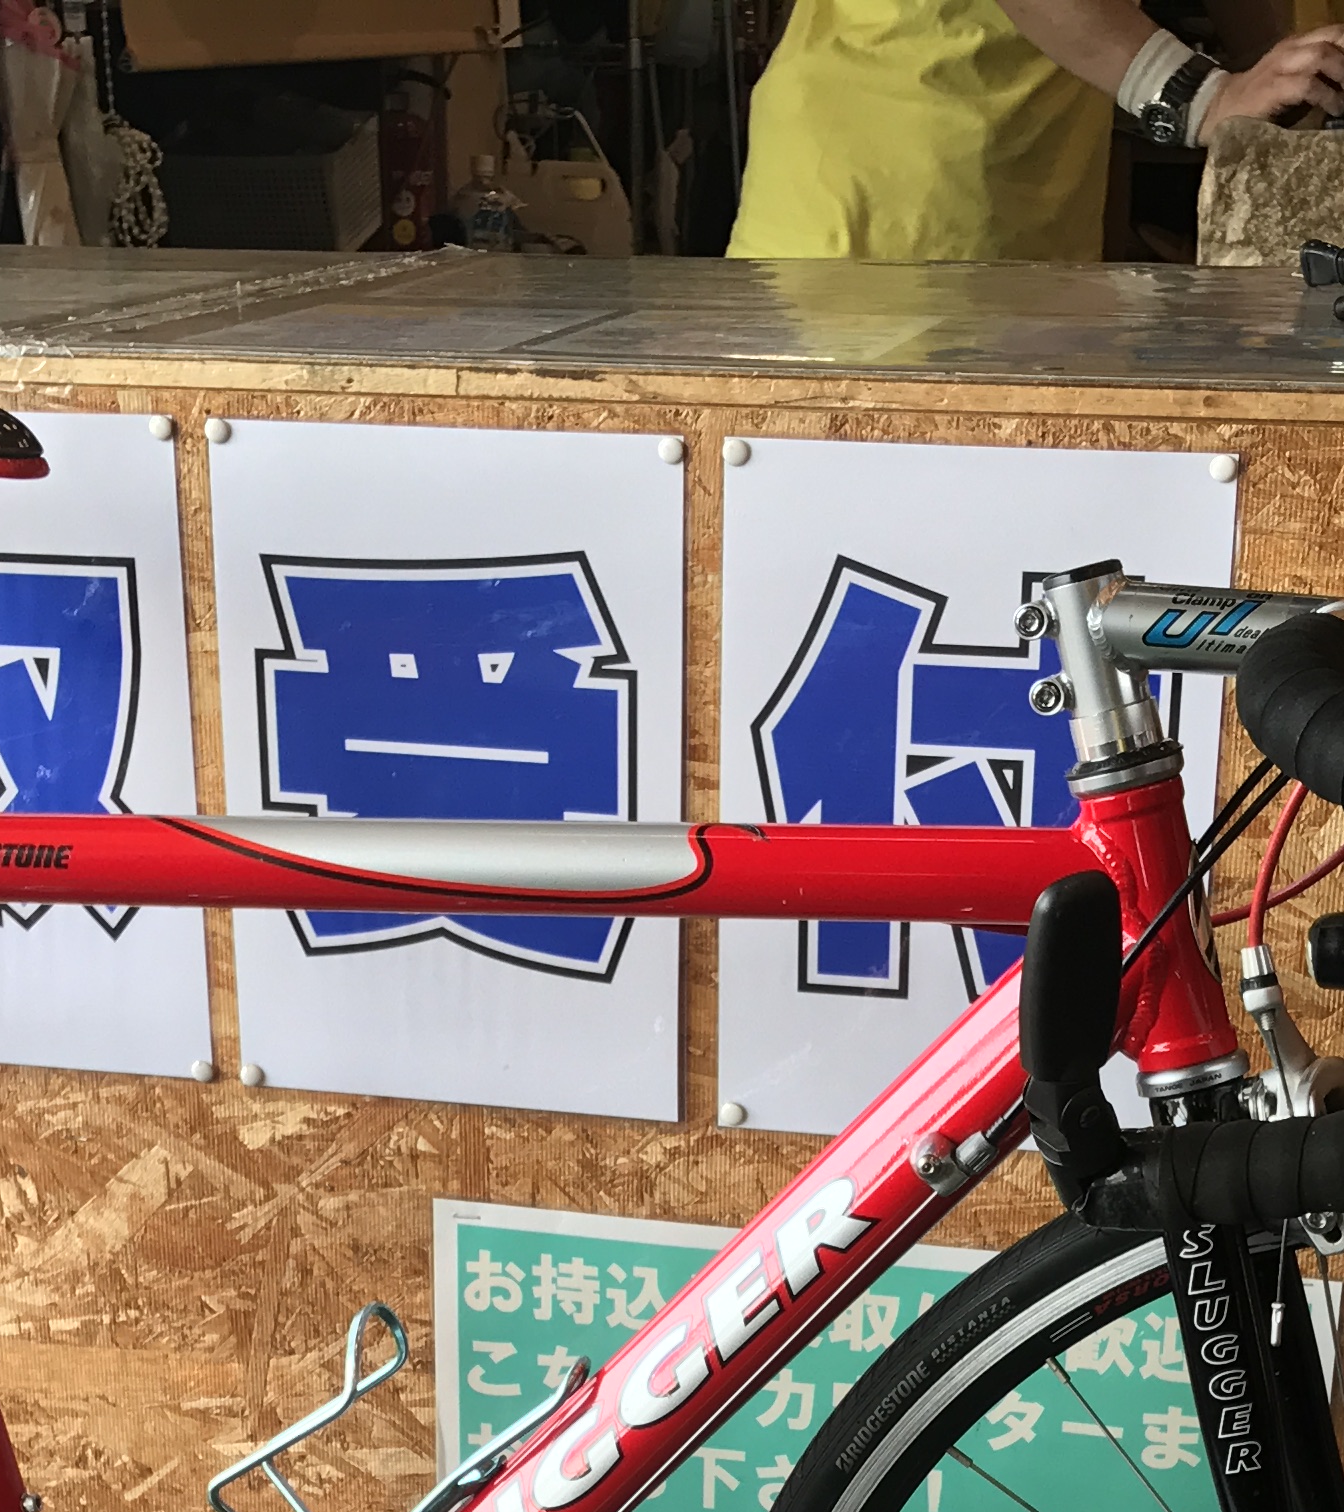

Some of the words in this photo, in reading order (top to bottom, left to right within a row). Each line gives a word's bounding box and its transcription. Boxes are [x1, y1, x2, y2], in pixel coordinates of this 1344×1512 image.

[1171, 592, 1237, 611] Clamp
[1179, 1223, 1263, 1476] SLUGGER
[834, 1360, 932, 1474] BRIDGESTONE
